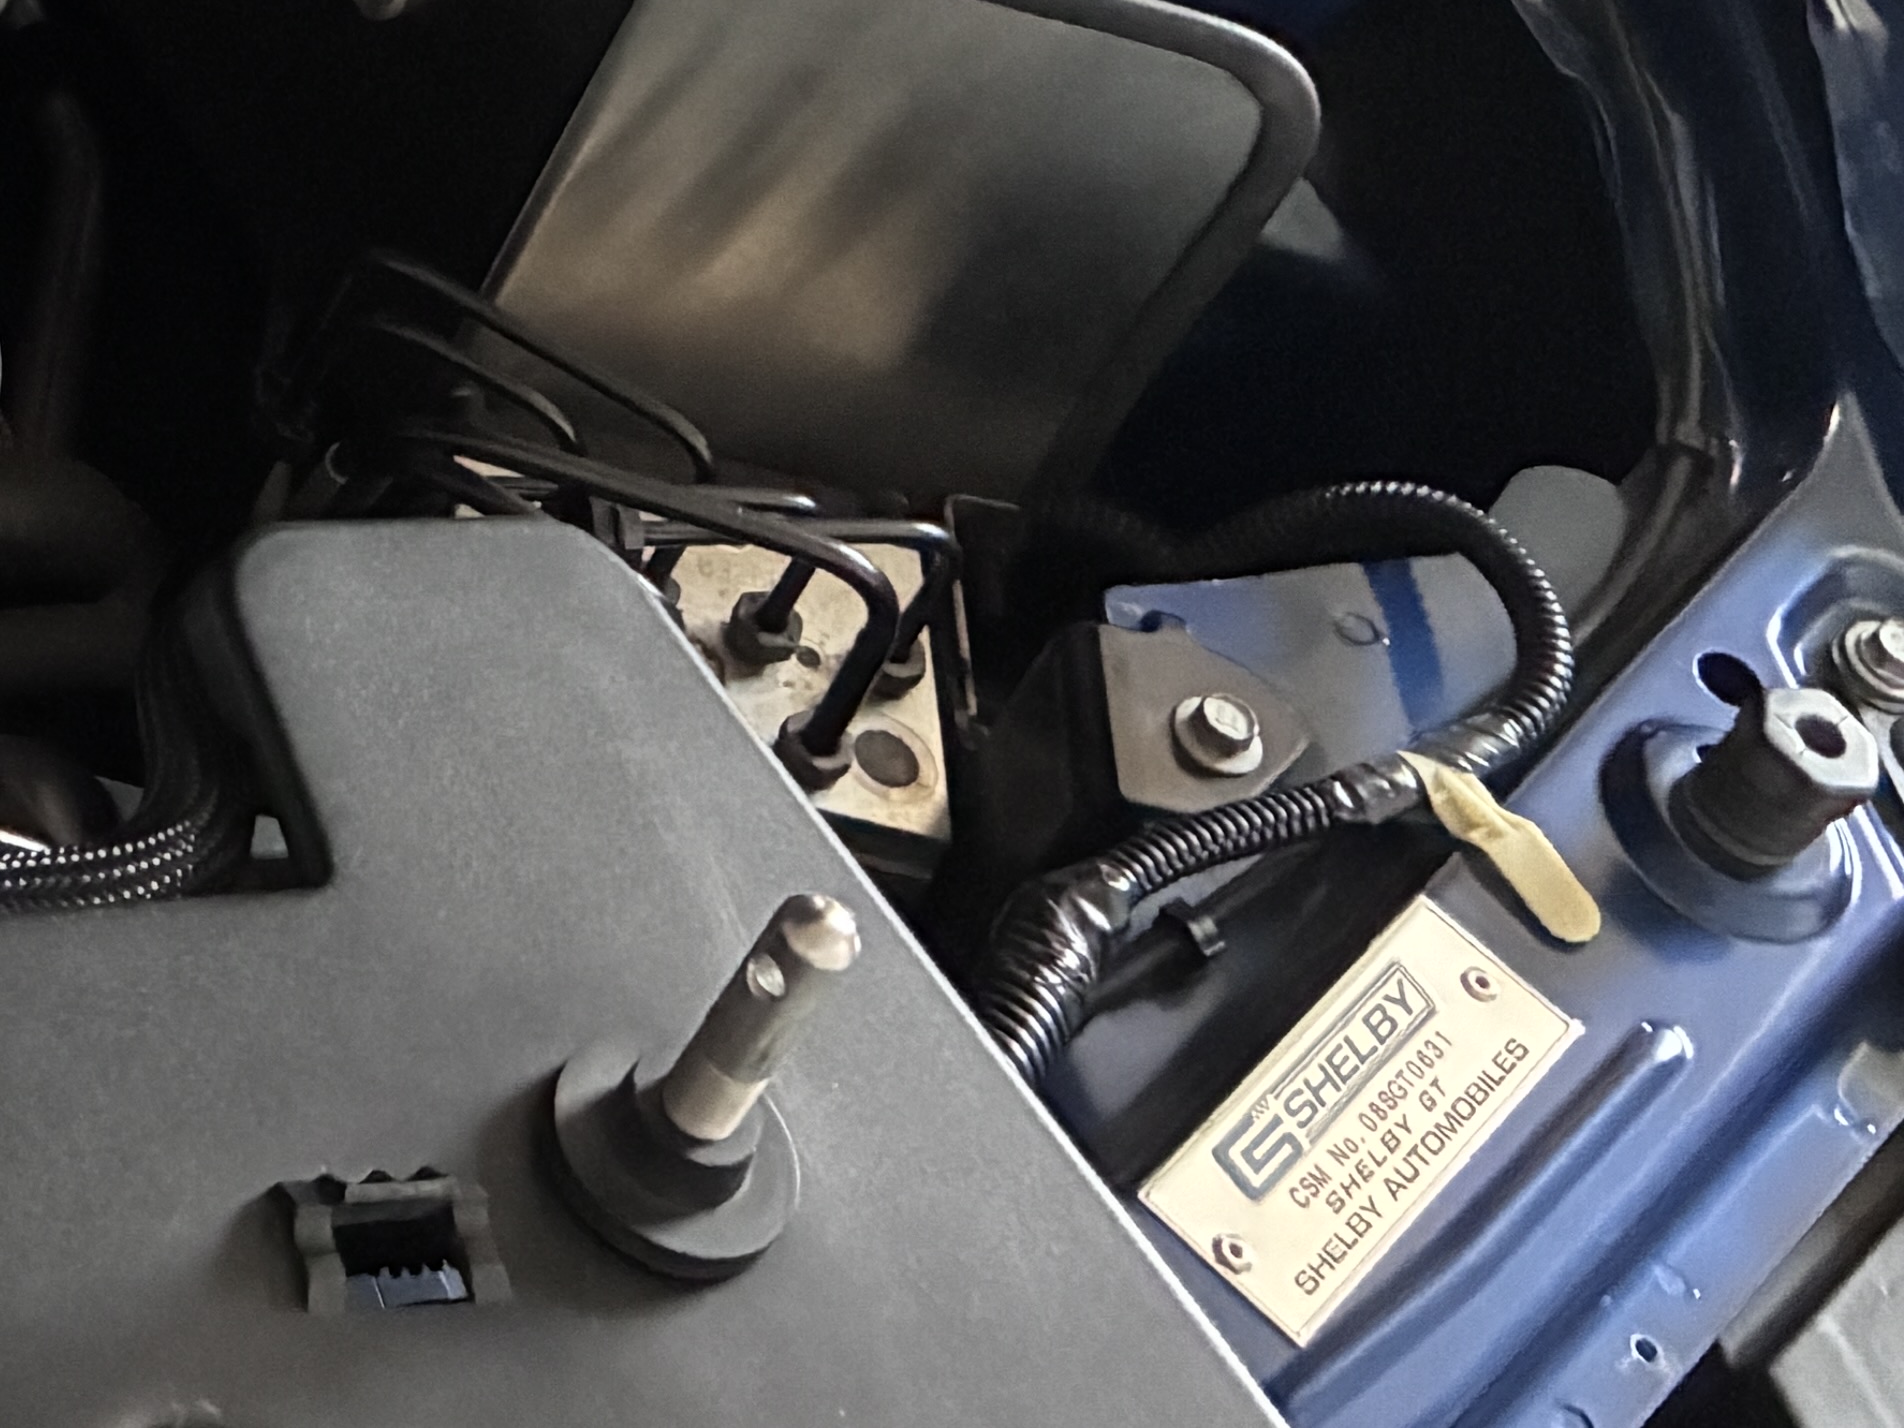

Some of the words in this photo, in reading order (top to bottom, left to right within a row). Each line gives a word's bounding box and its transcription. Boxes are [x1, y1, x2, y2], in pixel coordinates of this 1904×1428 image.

[1284, 977, 1420, 1132] SHELBY
[1288, 1162, 1333, 1210] CSM
[1325, 1136, 1366, 1167] No.
[1293, 1194, 1384, 1297] SHELBY
[1382, 1037, 1531, 1203] AUTOMOBILES
[1324, 1112, 1414, 1215] SHELBY
[1417, 1075, 1447, 1113] GT
